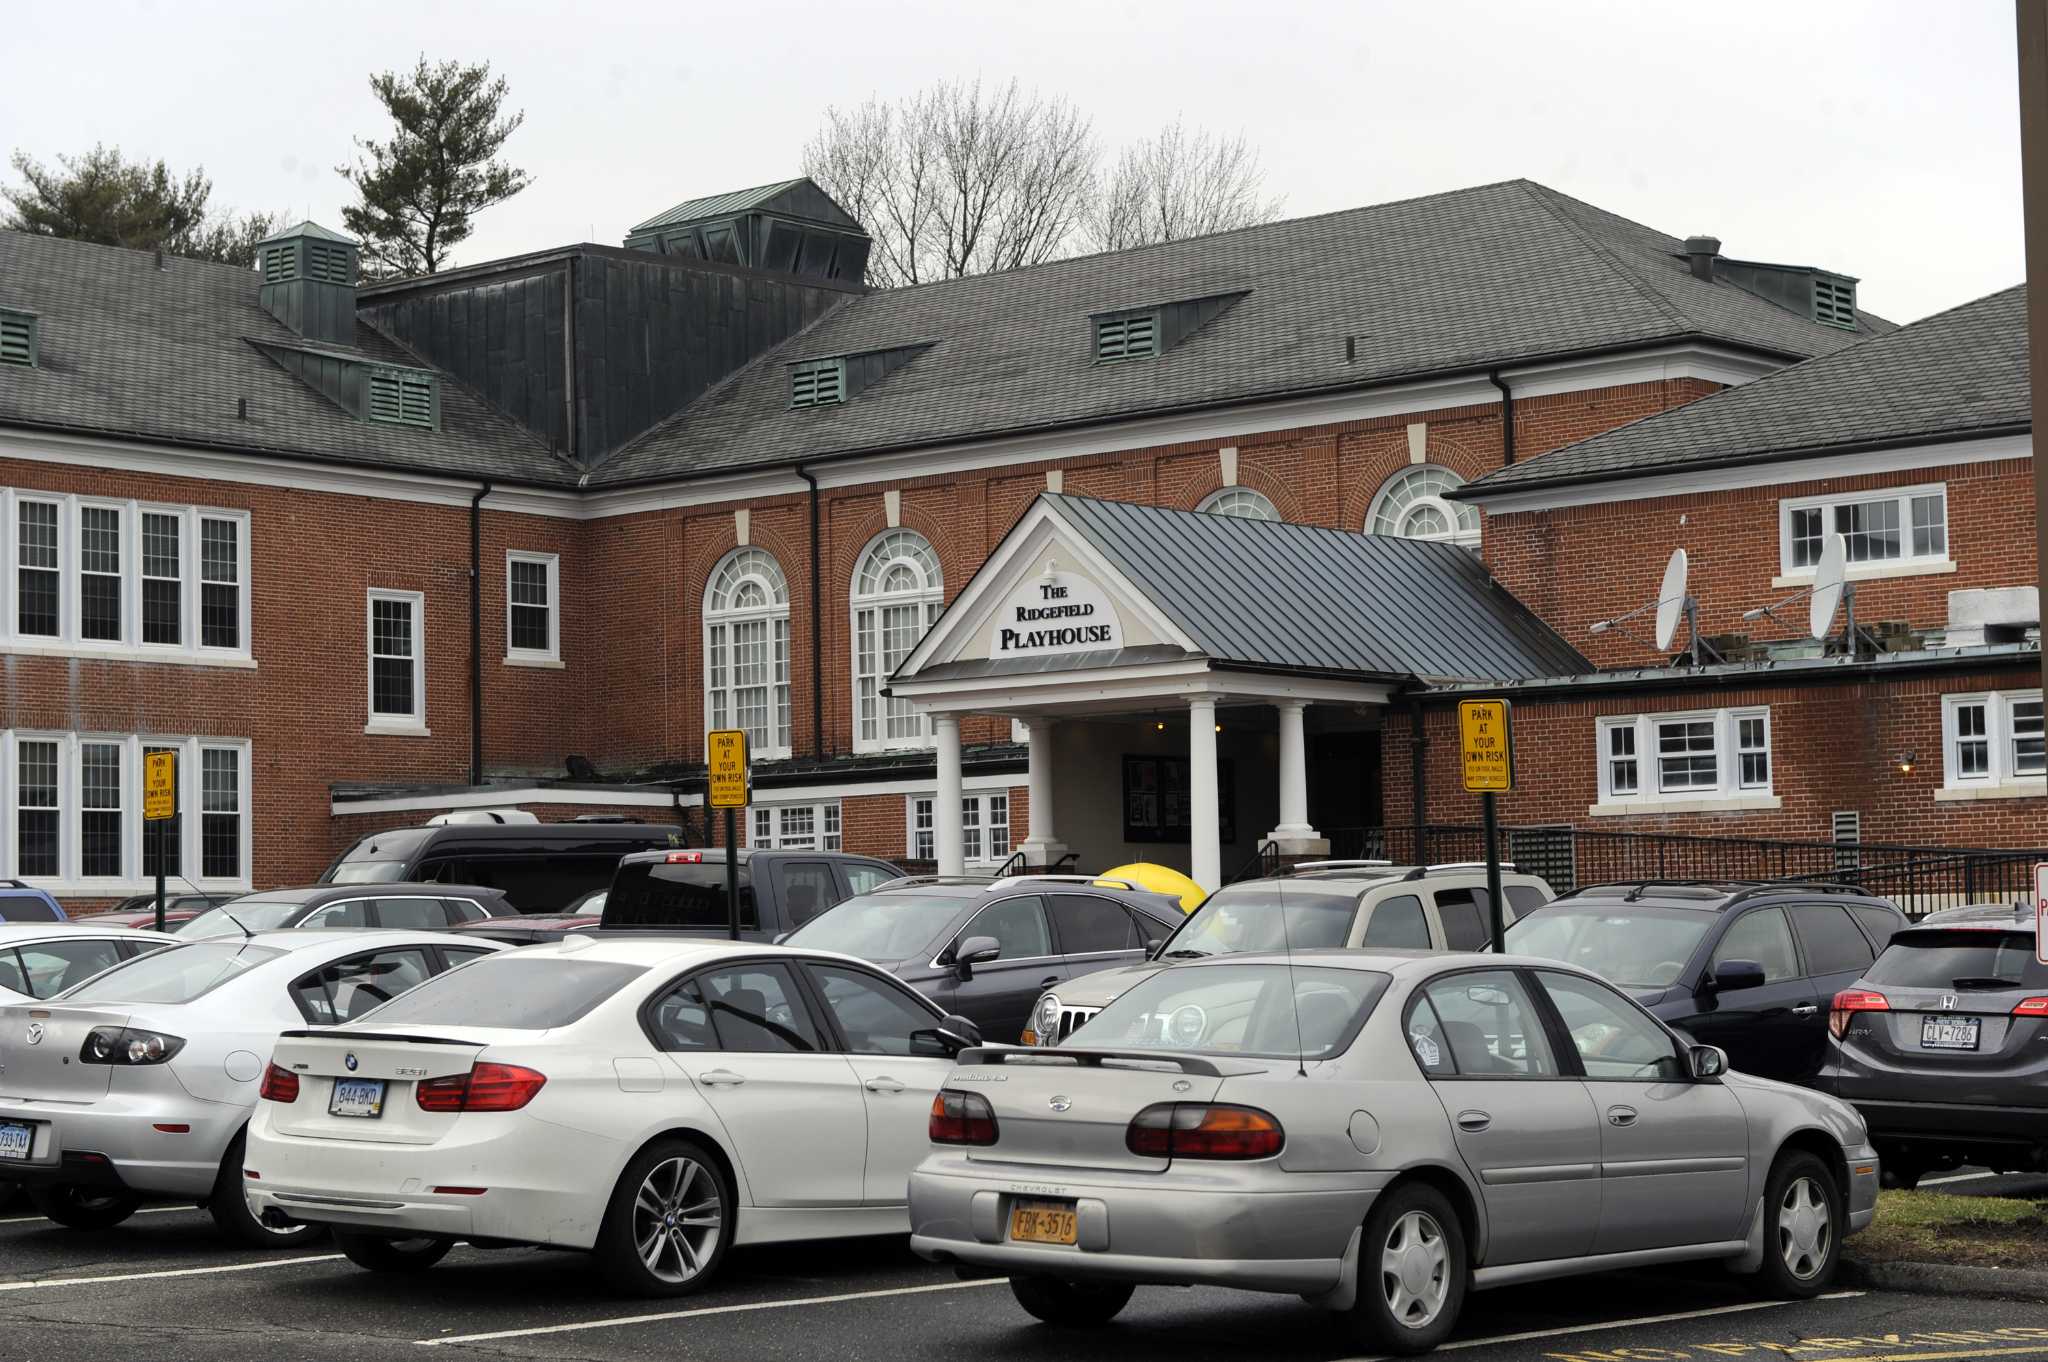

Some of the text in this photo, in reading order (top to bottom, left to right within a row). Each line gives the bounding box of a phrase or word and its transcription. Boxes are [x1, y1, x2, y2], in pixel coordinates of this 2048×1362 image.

[1040, 584, 1068, 600] THE
[1016, 603, 1094, 622] RIDGEFIELD
[1000, 625, 1112, 650] PLAYHOUSE
[1471, 709, 1493, 720] PARK
[1479, 723, 1488, 734] AT
[717, 737, 735, 748] PARK
[1473, 737, 1495, 748] YOUR
[723, 749, 730, 759] AT
[1466, 751, 1505, 762] OWN RISK
[718, 761, 736, 772] YOUR
[712, 773, 742, 784] OWN RISK
[1010, 1183, 1067, 1194] CHEVROLET
